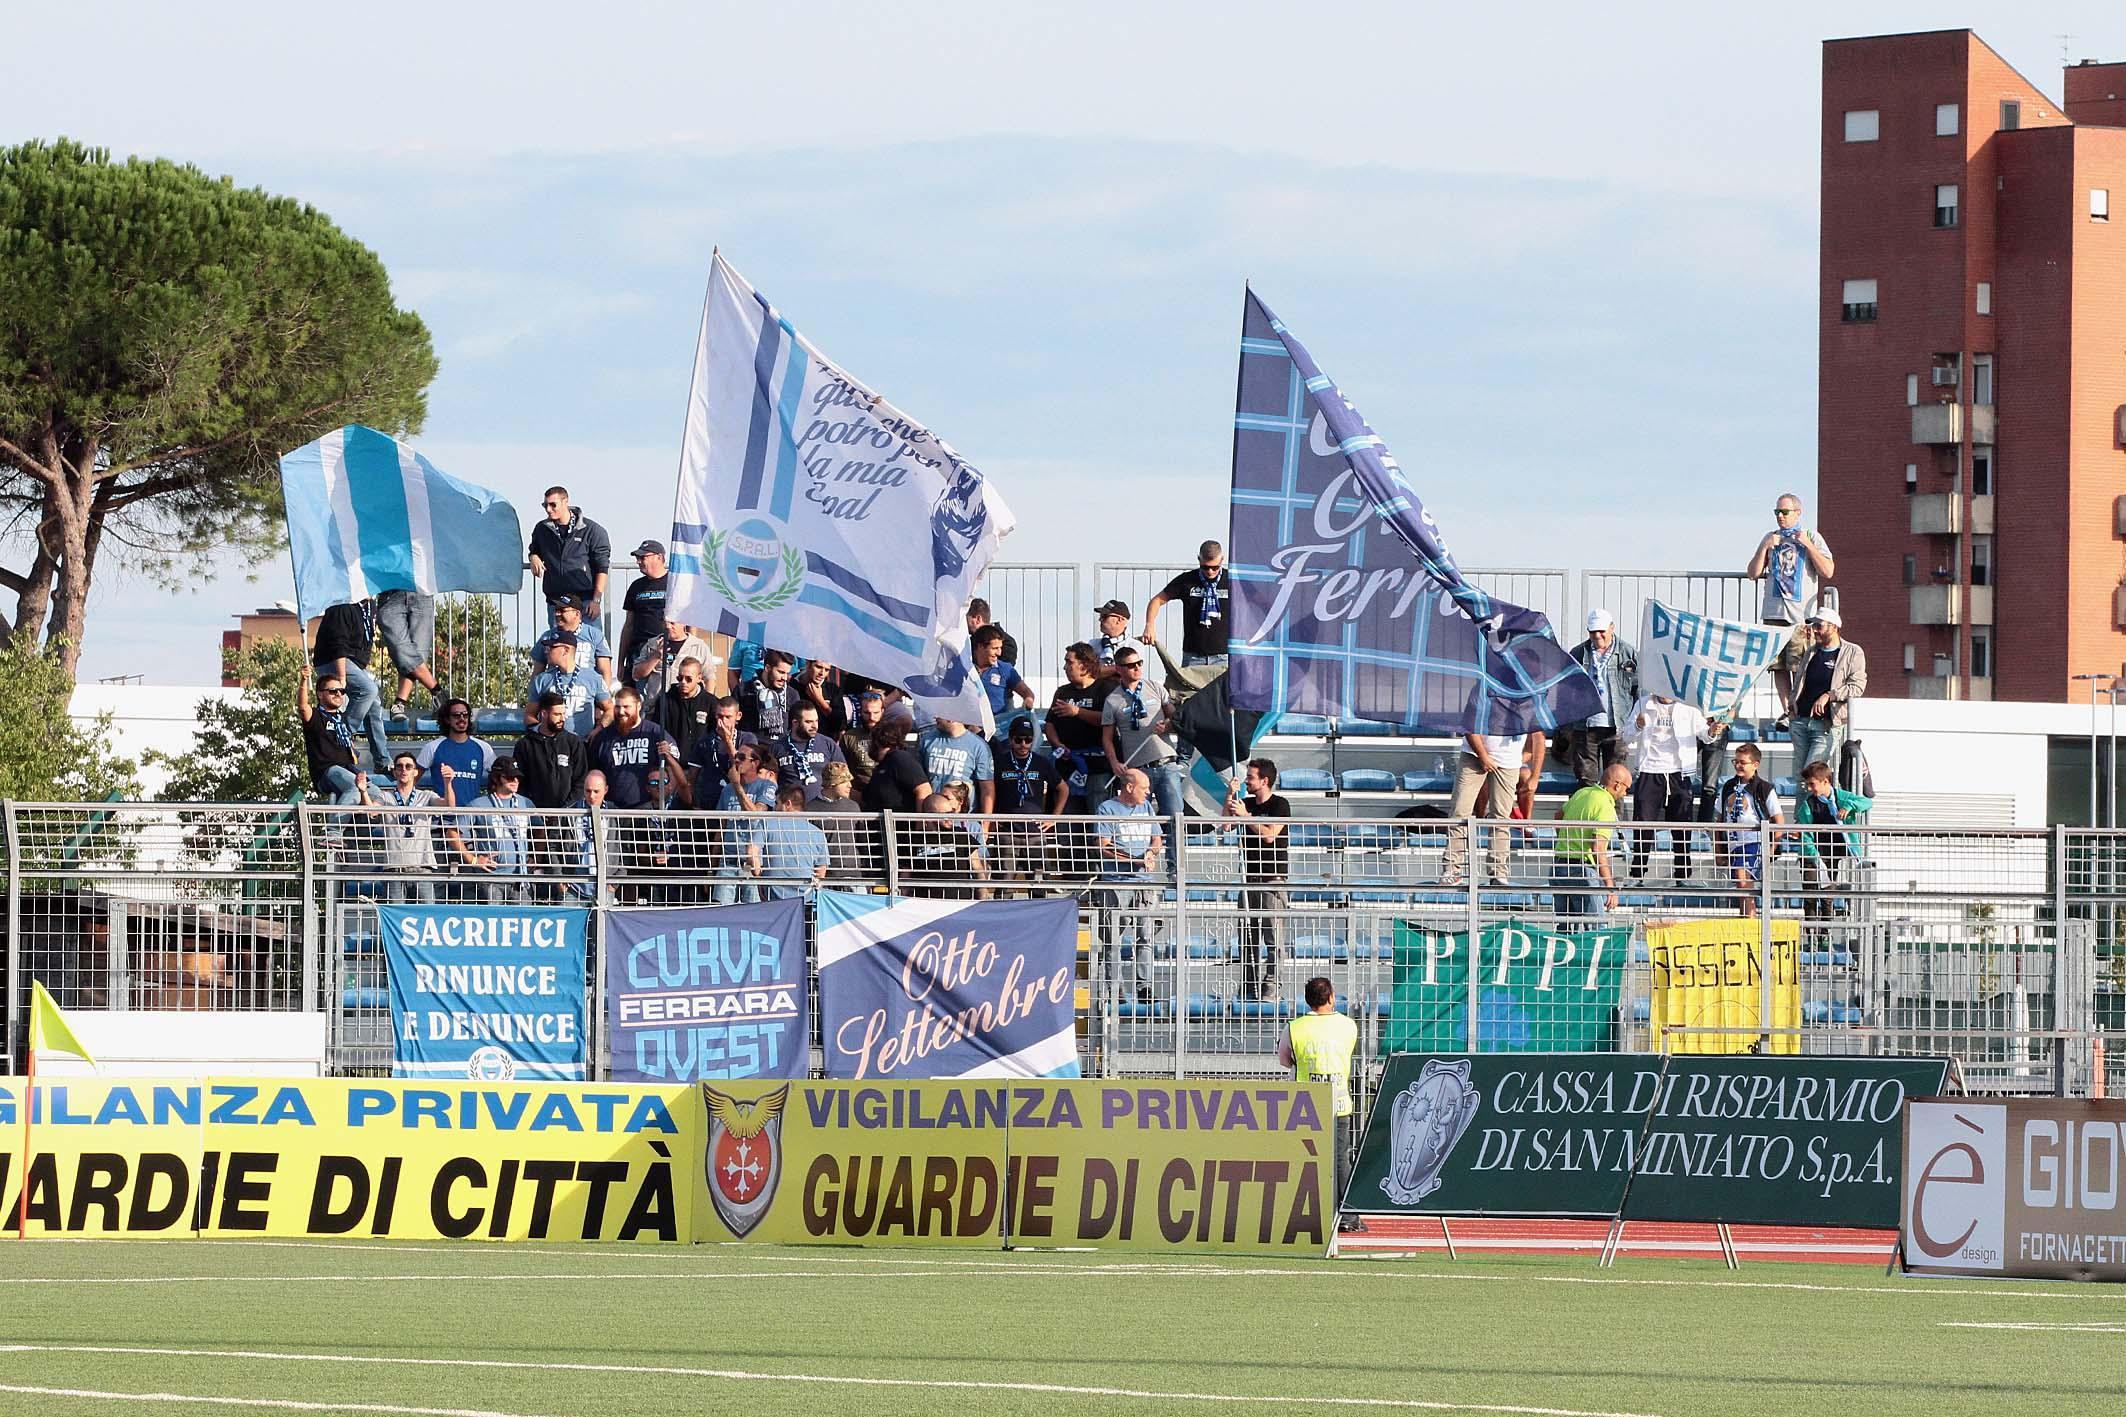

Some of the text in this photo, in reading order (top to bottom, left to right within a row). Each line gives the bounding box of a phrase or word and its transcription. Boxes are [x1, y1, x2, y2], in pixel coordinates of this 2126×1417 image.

[834, 458, 910, 488] mia
[612, 748, 649, 766] VIVE
[928, 757, 965, 777] VIVE
[401, 916, 568, 948] SACRIFICI
[628, 927, 782, 989] CURVA
[415, 964, 557, 996] RINUNCE
[902, 930, 1001, 1001] Otto
[1421, 928, 1610, 991] PPPI
[402, 1011, 575, 1043] E DENUNCE
[619, 990, 797, 1021] FERRARA
[836, 954, 1070, 1079] Settembre
[635, 1022, 785, 1082] OVEST
[347, 1088, 679, 1134] PRIVATA
[803, 1088, 1323, 1132] VIGILANZA PRIVATA
[1493, 1071, 1905, 1124] CASSA DI RISPARMIO
[1471, 1128, 1894, 1198] DI SAN MINIATO S.p.A.
[2023, 1119, 2126, 1211] GIO
[306, 1156, 403, 1235] DI
[429, 1142, 678, 1242] CITTÀ
[802, 1139, 1324, 1246] GUARDIE DI CITTÀ
